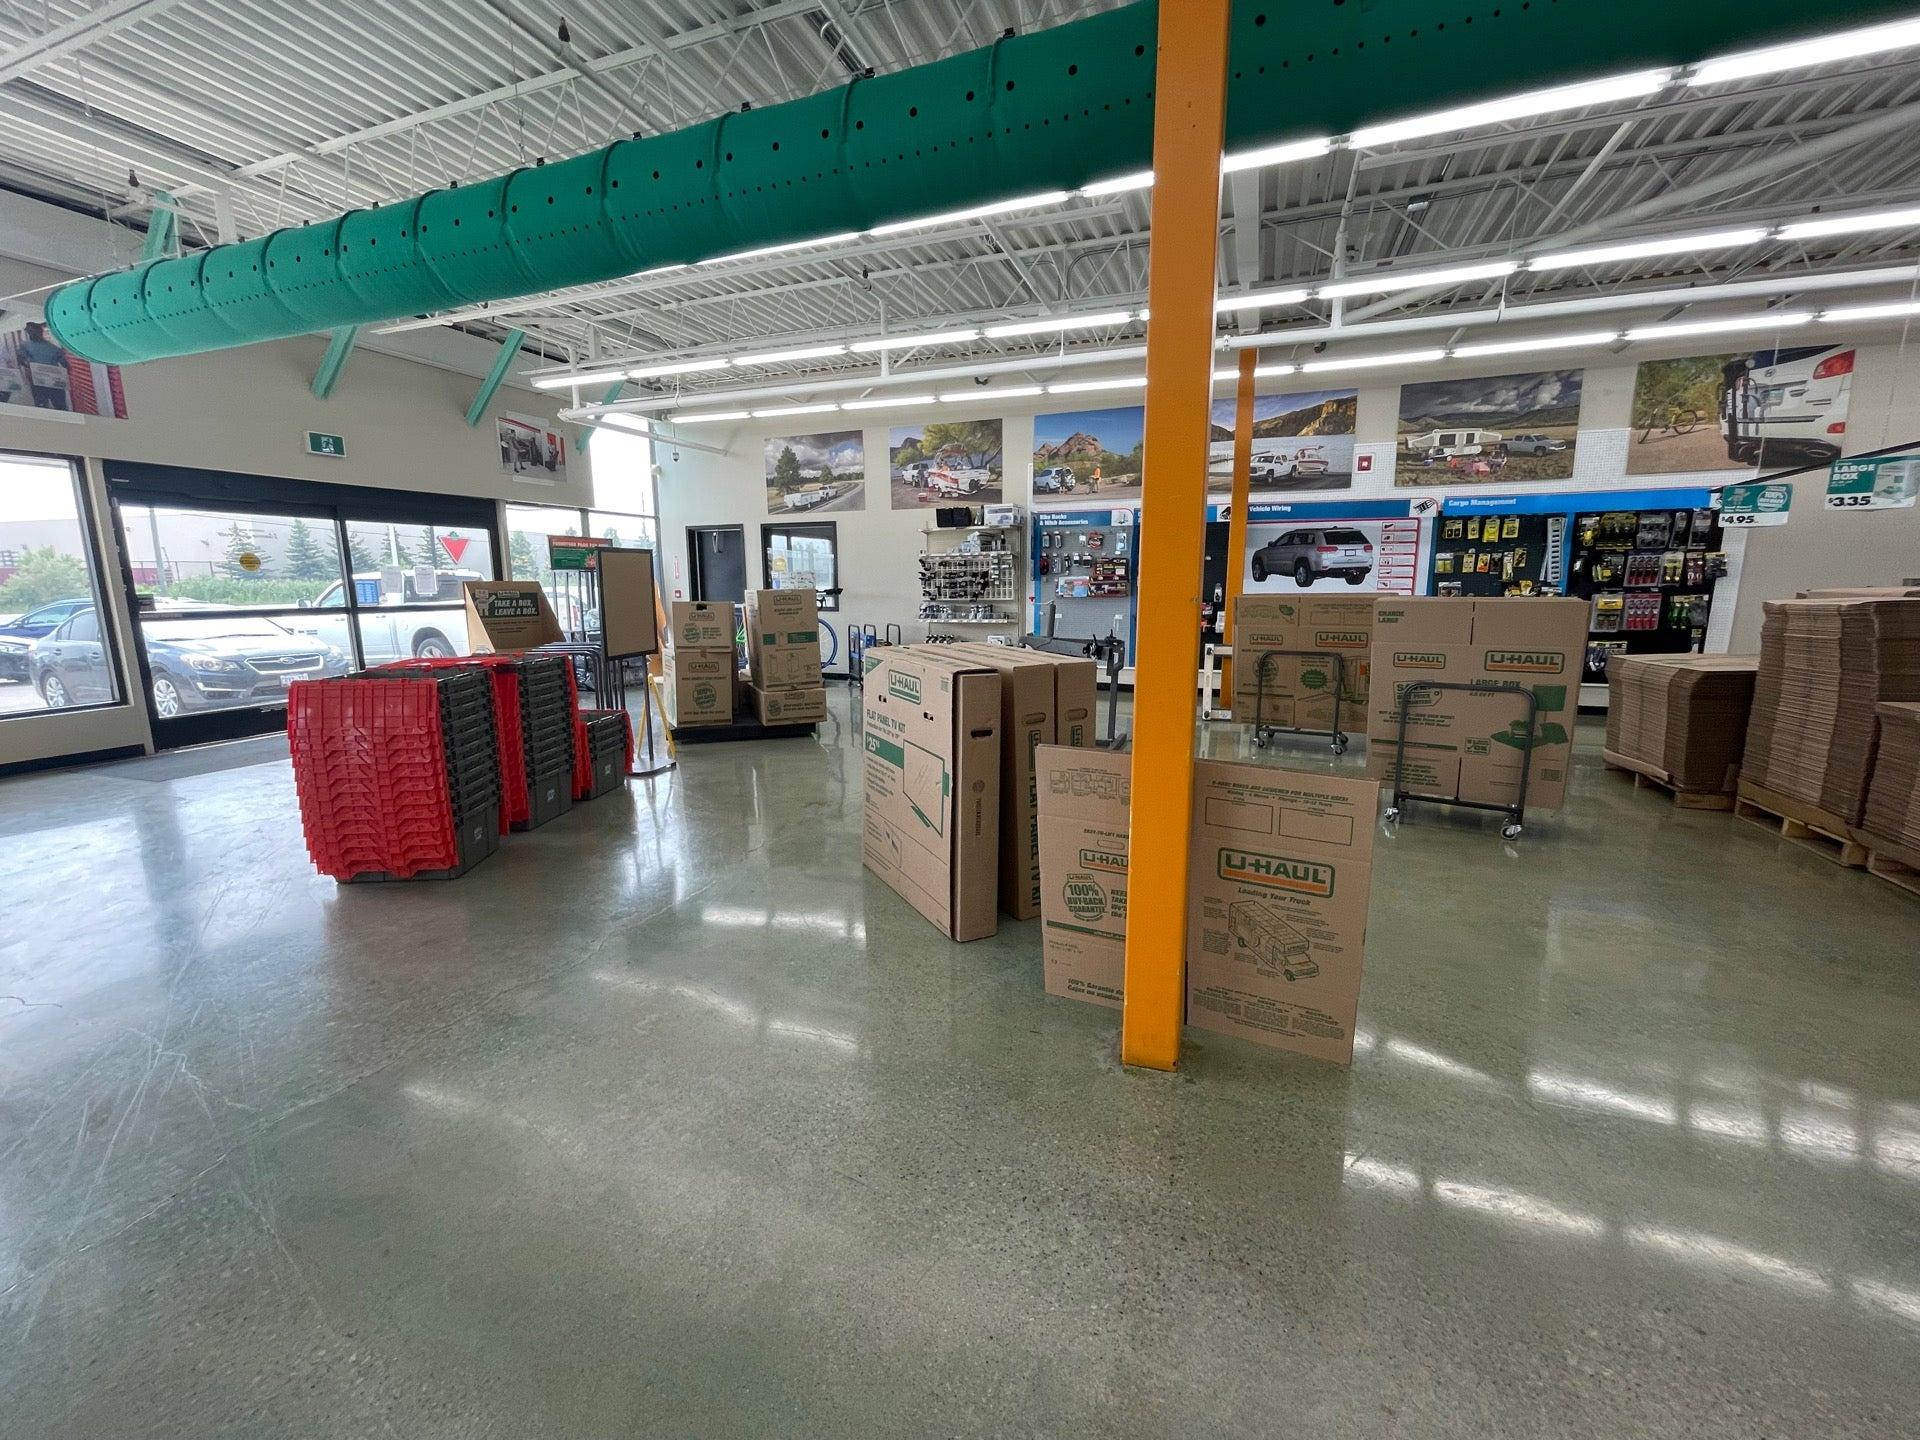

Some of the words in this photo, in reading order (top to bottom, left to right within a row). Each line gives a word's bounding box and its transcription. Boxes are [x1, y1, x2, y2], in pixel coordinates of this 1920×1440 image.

[1834, 464, 1876, 473] LARGE
[1448, 499, 1469, 508] Cargo
[1470, 498, 1516, 507] Management
[1828, 496, 1871, 506] $3.35
[1722, 515, 1755, 524] $4.95
[1318, 634, 1365, 642] U-HAUL
[1397, 655, 1442, 664] U-HAUL
[1490, 654, 1560, 666] U-HAUL
[890, 674, 919, 693] U-HAUL
[1470, 679, 1498, 687] LARGE
[867, 709, 876, 720] FLAT
[877, 713, 891, 727] PANEL
[891, 719, 897, 730] TV
[1083, 852, 1128, 867] U-HAU
[1225, 853, 1326, 884] U-HAUL
[1068, 884, 1099, 896] 100%
[1067, 896, 1104, 905] BUY-BACK
[1238, 887, 1268, 899] Loading
[1270, 892, 1287, 902] Your
[1290, 896, 1311, 906] Truck
[1068, 978, 1085, 986] 100%
